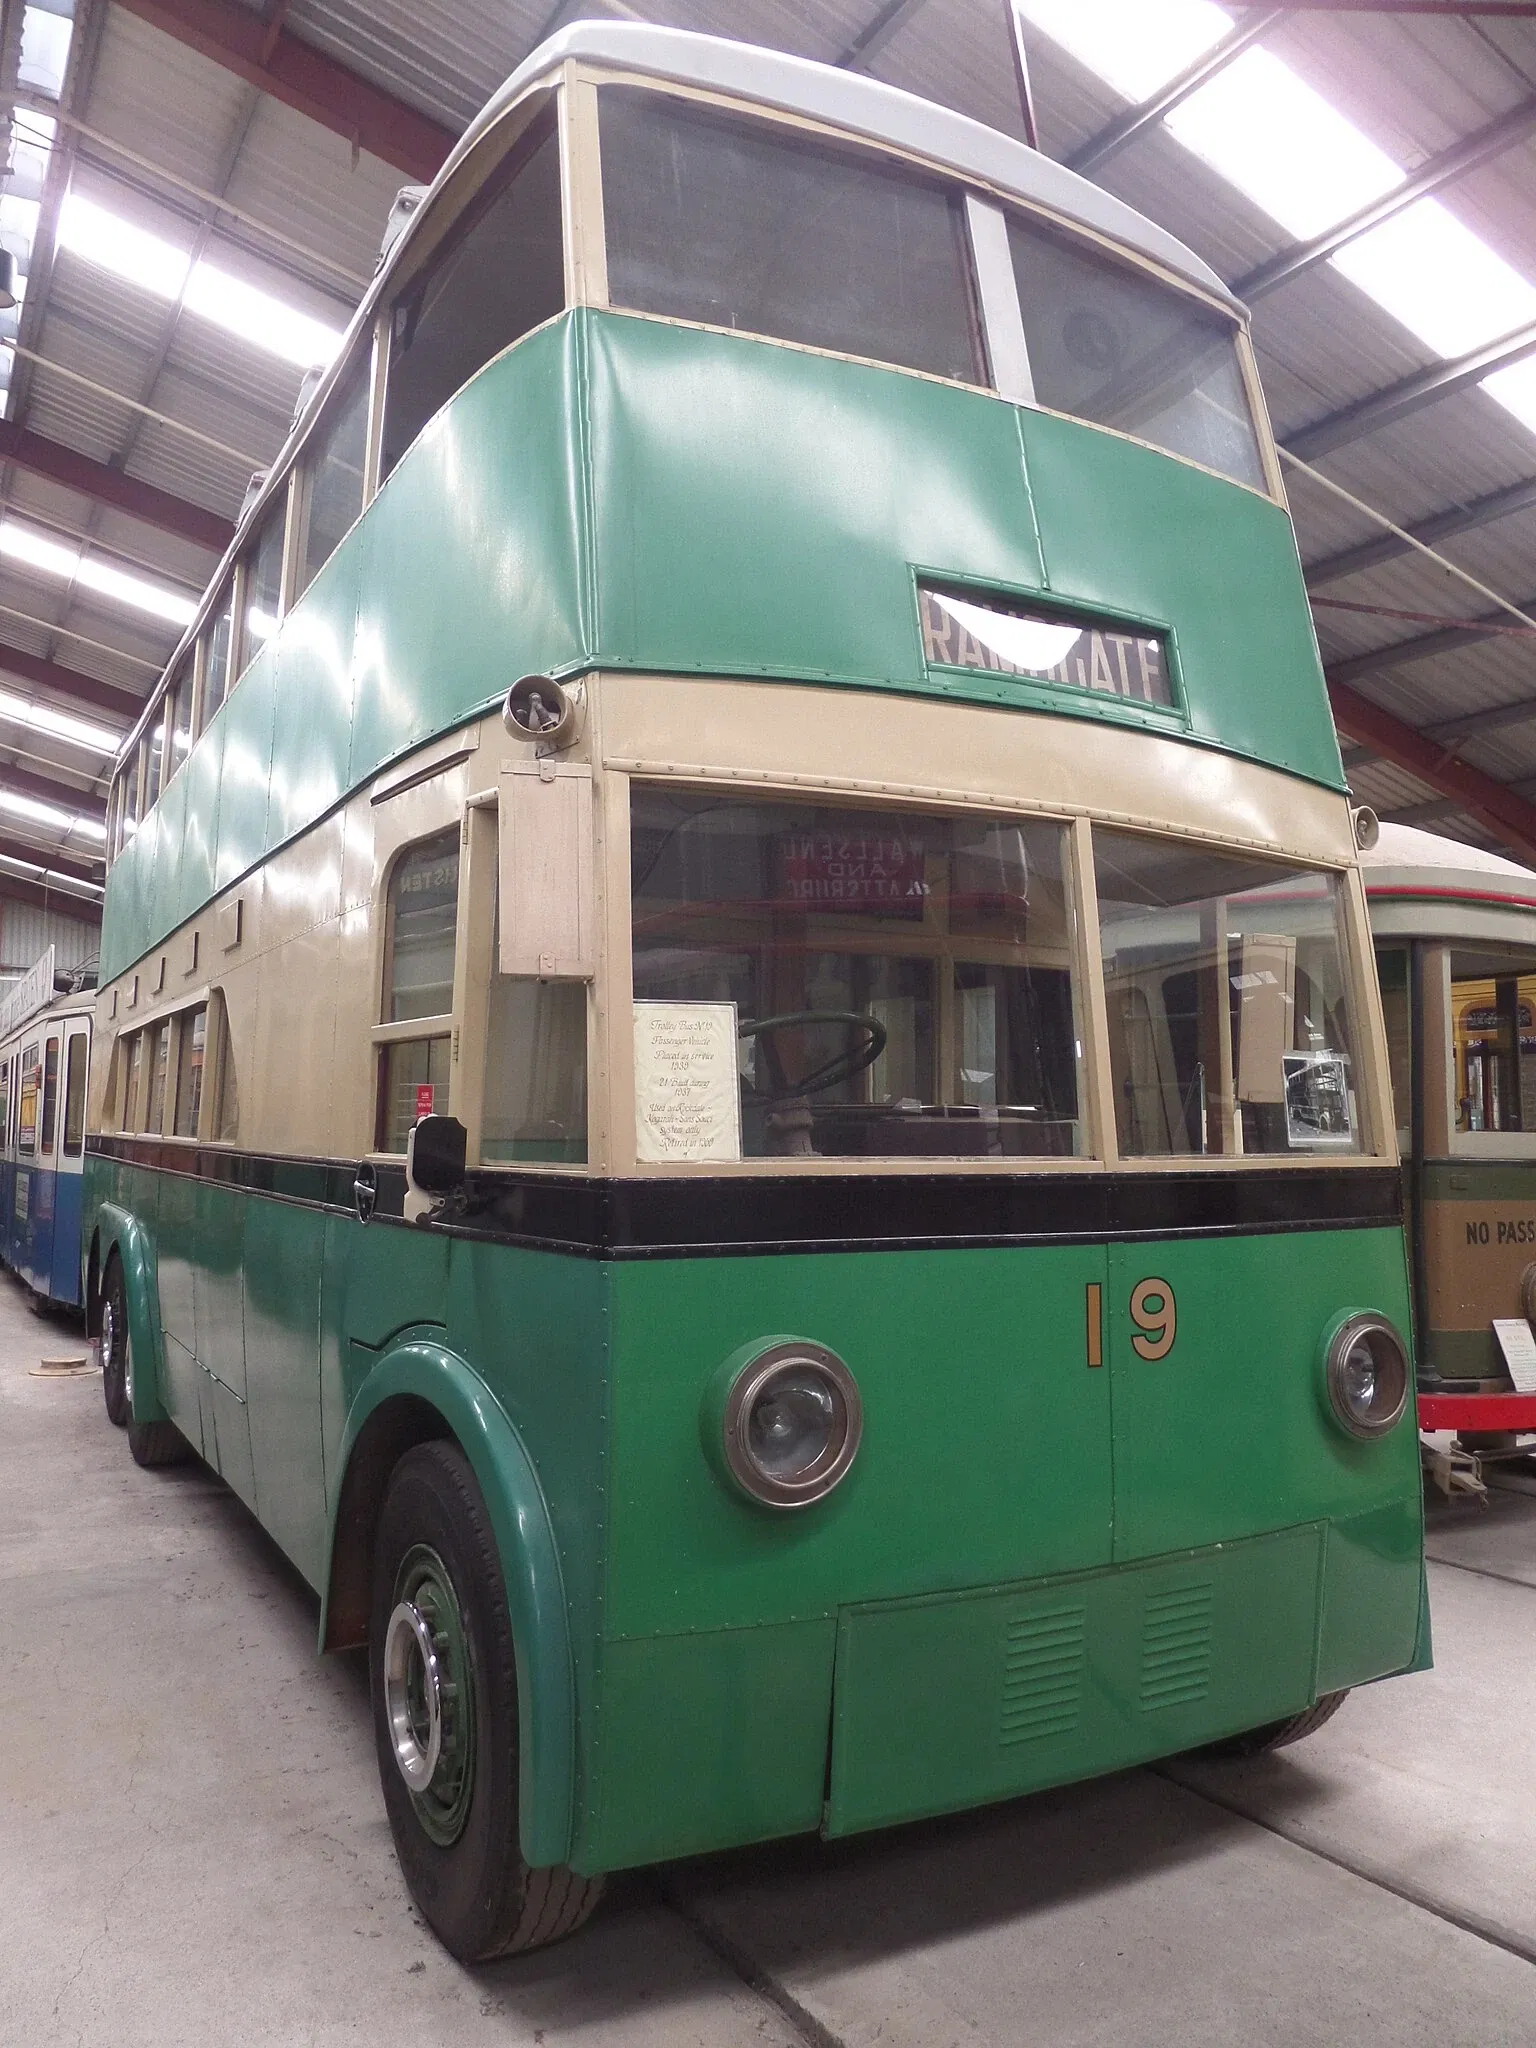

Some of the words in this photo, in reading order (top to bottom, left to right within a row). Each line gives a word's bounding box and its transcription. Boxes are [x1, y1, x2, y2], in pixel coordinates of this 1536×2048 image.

[920, 588, 1161, 702] RAATE
[650, 1019, 677, 1033] Trolley
[678, 1020, 693, 1031] Bus
[651, 1035, 688, 1048] Passenger
[653, 1049, 680, 1060] Placed
[649, 1103, 666, 1112] Used
[1466, 1221, 1490, 1245] NO
[1497, 1220, 1536, 1245] PASS
[1086, 1276, 1178, 1369] 19
